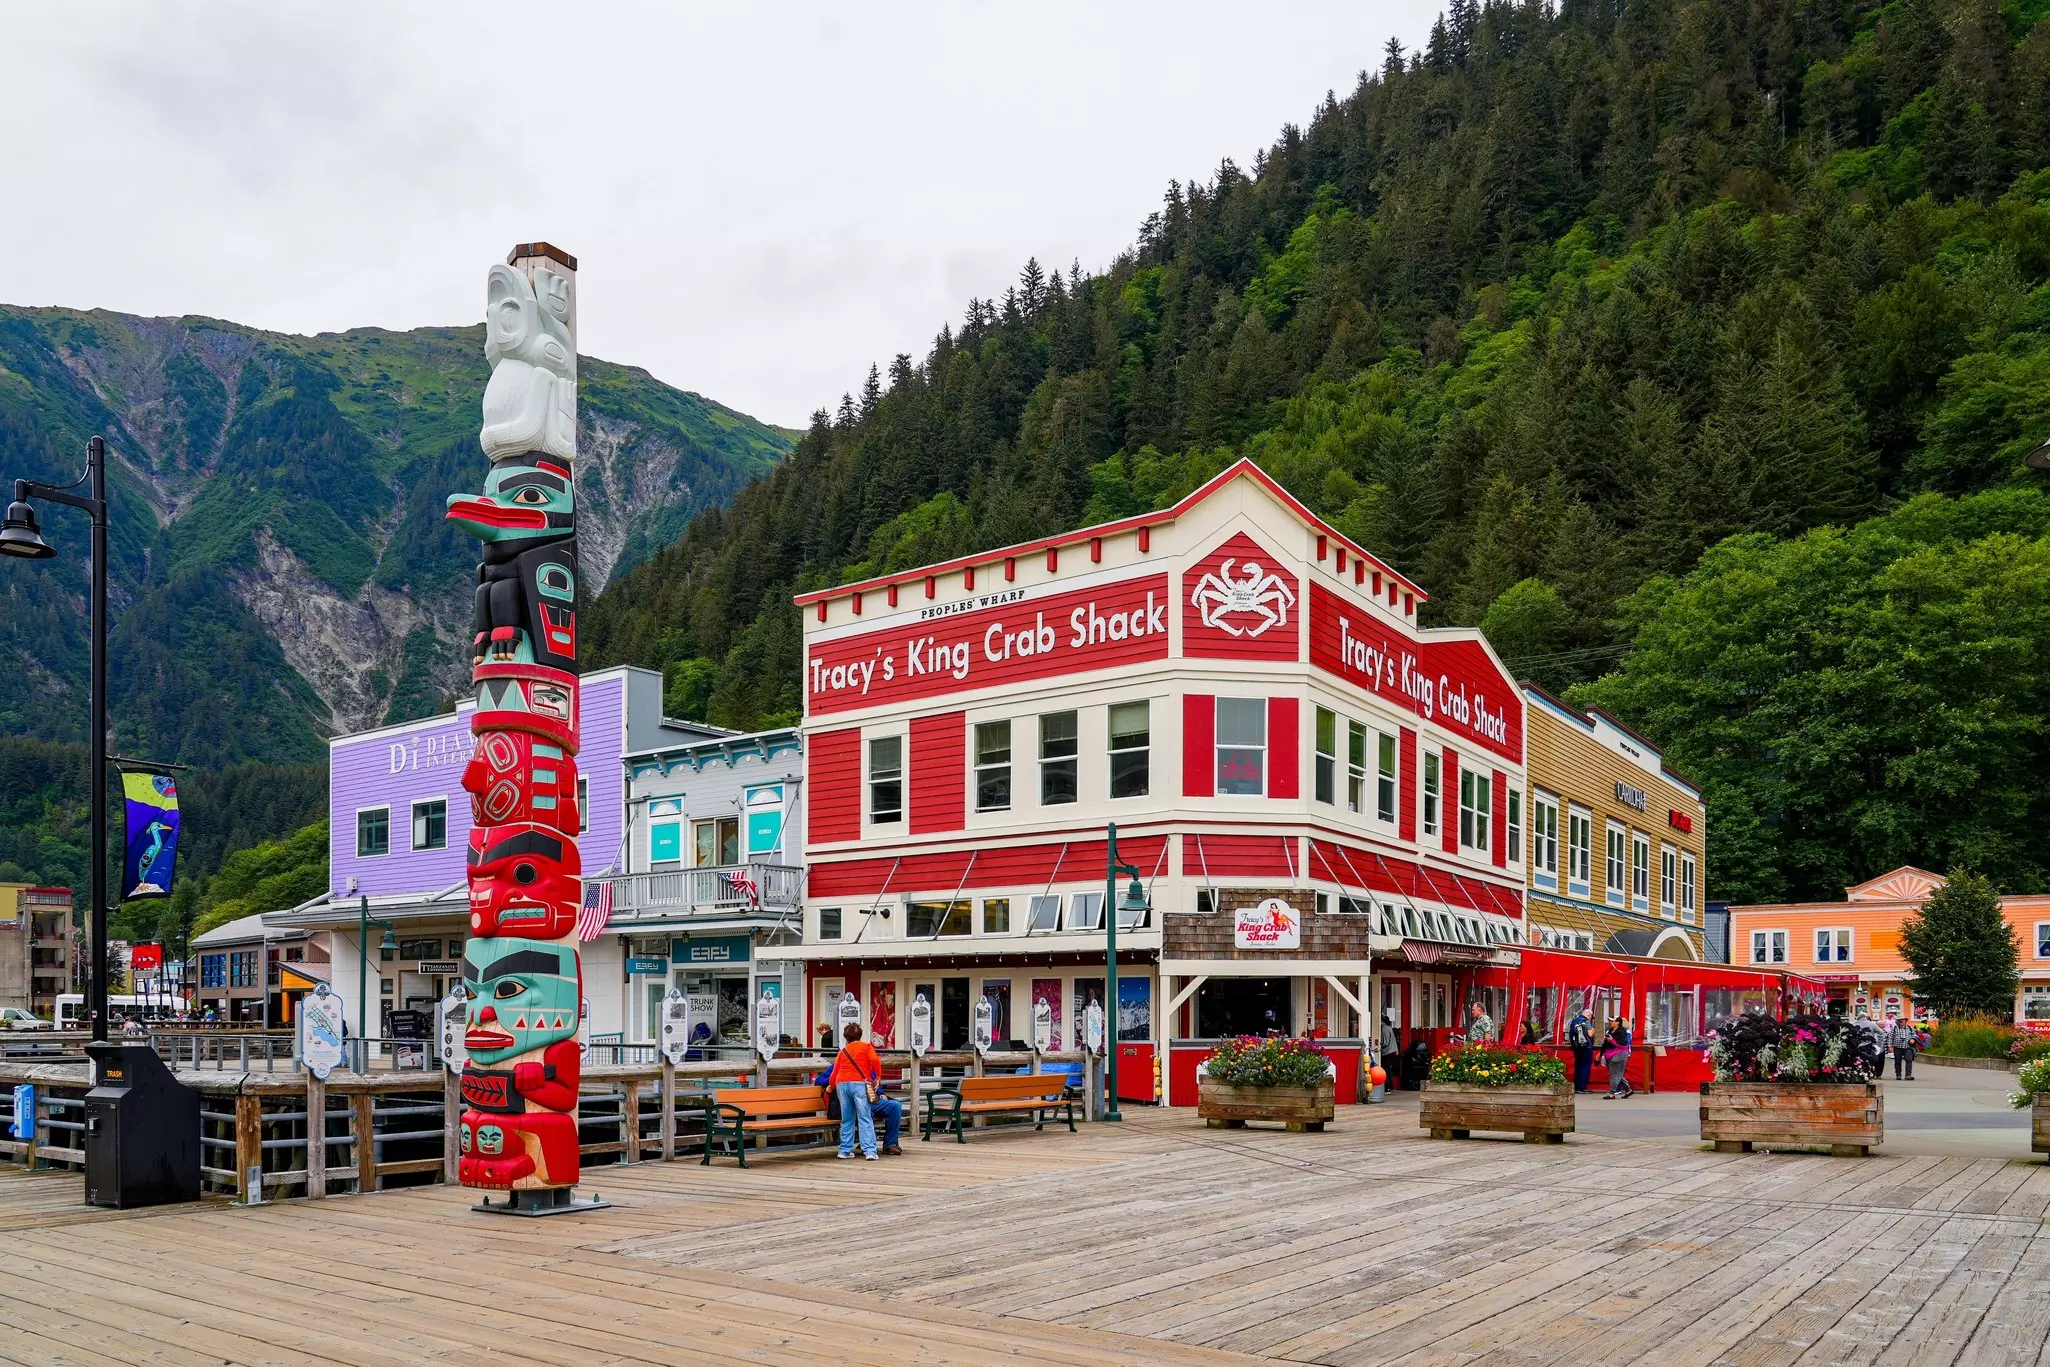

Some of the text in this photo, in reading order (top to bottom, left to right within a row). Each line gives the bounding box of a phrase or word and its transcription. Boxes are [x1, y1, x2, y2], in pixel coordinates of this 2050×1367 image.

[921, 590, 1025, 618] PEOPLES' WHARF
[811, 591, 1165, 694] Tracy's King Crab Shack
[1339, 616, 1507, 746] Tracy's King Crab Shack
[1241, 913, 1264, 924] Tracy's
[1238, 923, 1262, 933] King
[1246, 932, 1279, 941] Shack
[691, 946, 729, 960] EFFY
[690, 1004, 714, 1012] SHOW
